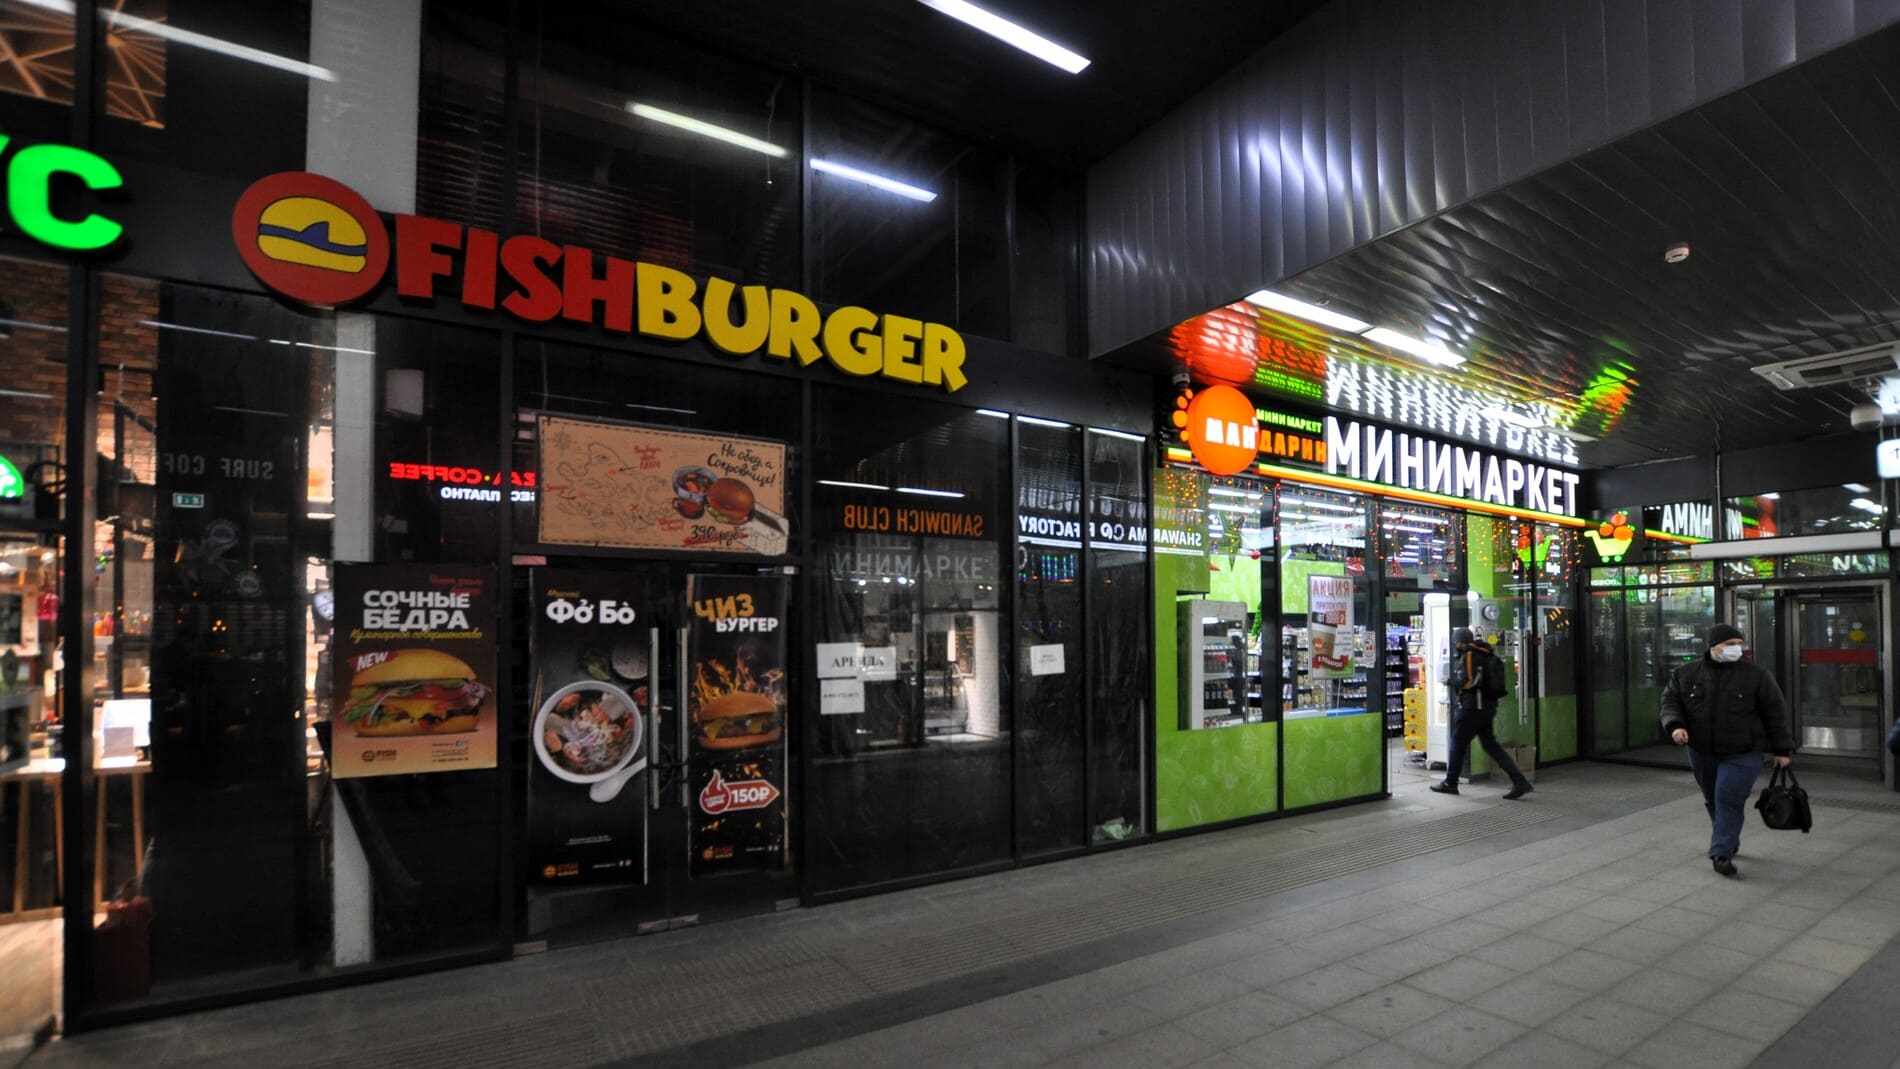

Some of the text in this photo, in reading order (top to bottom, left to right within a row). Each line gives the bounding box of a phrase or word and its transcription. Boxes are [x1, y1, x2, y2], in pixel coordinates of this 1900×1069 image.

[0, 134, 123, 249] С
[1256, 408, 1322, 433] МИНИ МАРКЕТ
[1326, 416, 1580, 517] МИНИМАРКЕТ
[691, 525, 716, 541] 390
[362, 590, 471, 609] СОЧНЫЕ
[1313, 580, 1350, 599] АКЦИЯ
[695, 593, 755, 623] ЧИЗ
[715, 617, 779, 633] БУРГЕР
[356, 651, 389, 673] NEW
